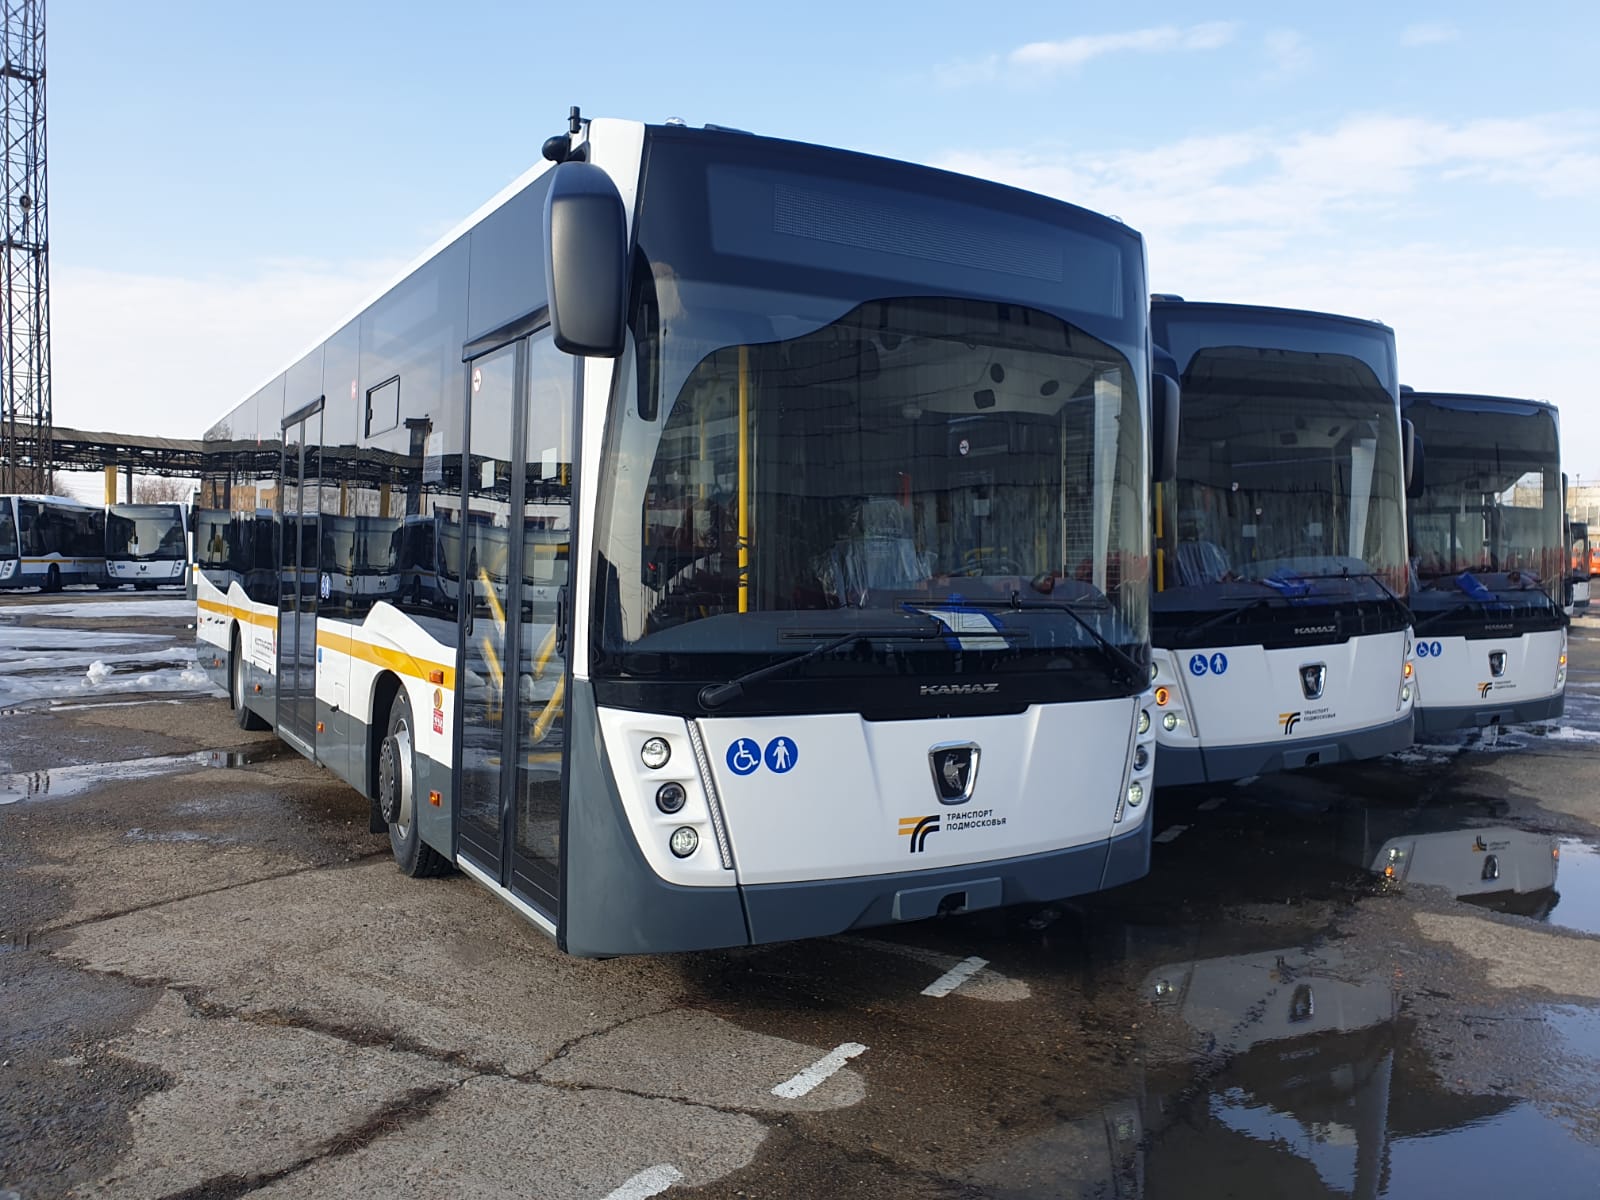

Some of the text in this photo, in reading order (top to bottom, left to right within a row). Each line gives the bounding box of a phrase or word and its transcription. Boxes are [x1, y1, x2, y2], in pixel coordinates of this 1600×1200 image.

[1294, 625, 1336, 634] KAMAZ
[919, 683, 1000, 696] KAMAZ
[946, 809, 993, 821] ТРАНСПОРТ
[946, 817, 1007, 831] ПОДМОСКОВЬЯ
